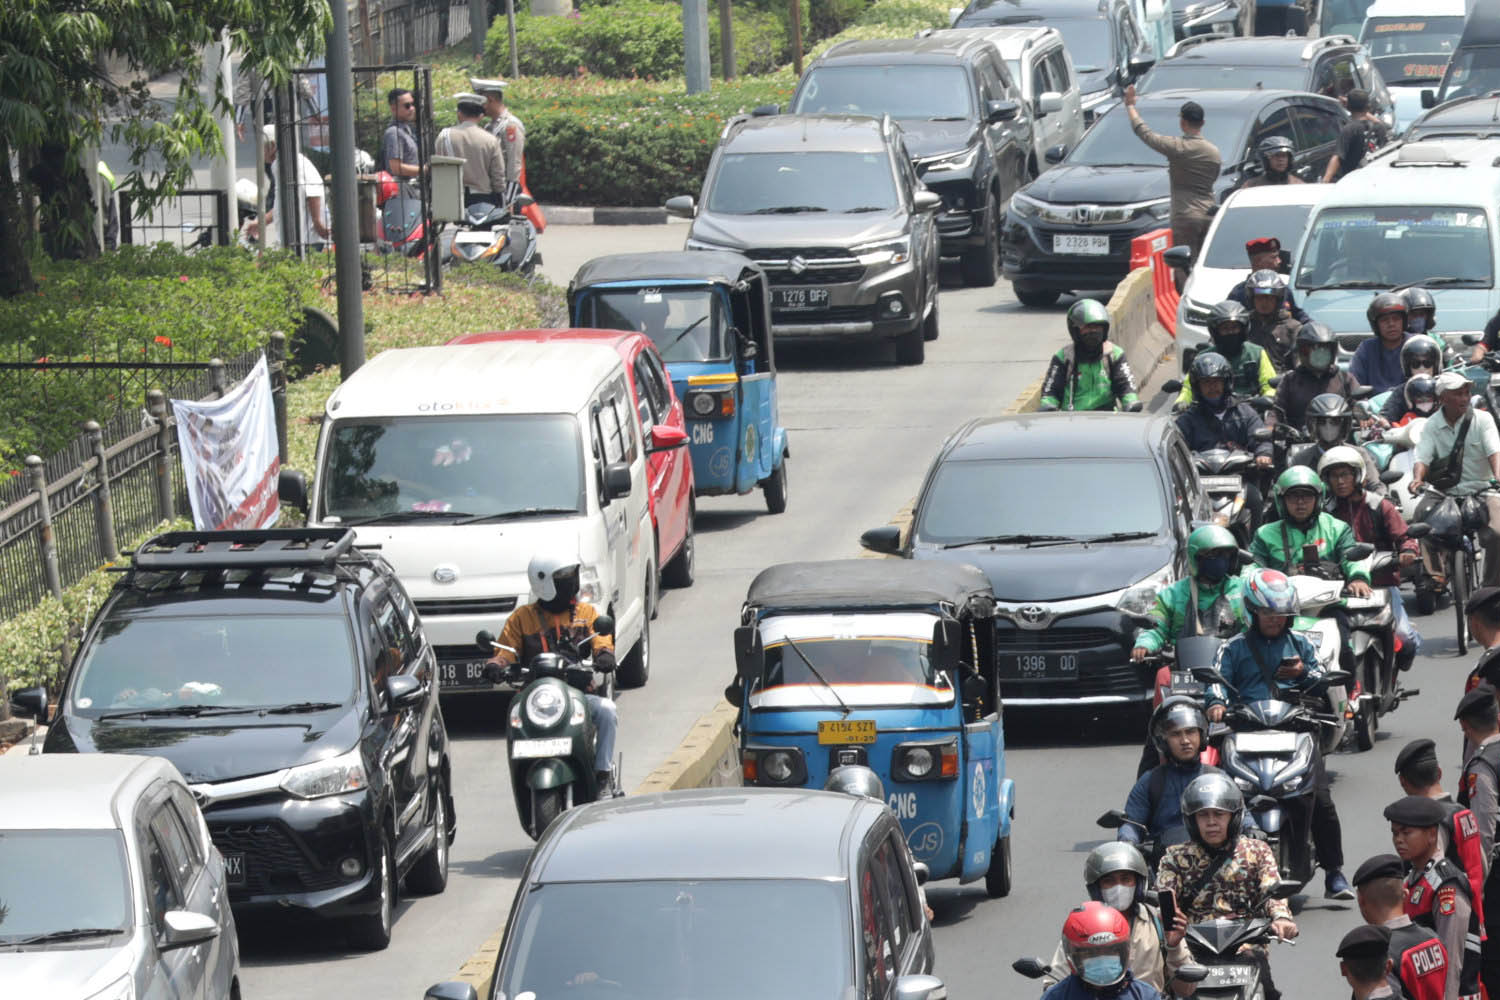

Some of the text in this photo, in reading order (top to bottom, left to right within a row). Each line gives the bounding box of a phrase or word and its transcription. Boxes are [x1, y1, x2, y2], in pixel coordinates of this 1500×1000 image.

[692, 423, 714, 444] CNG
[1016, 656, 1046, 671] 1396
[889, 793, 917, 819] CNG
[913, 832, 938, 852] JS
